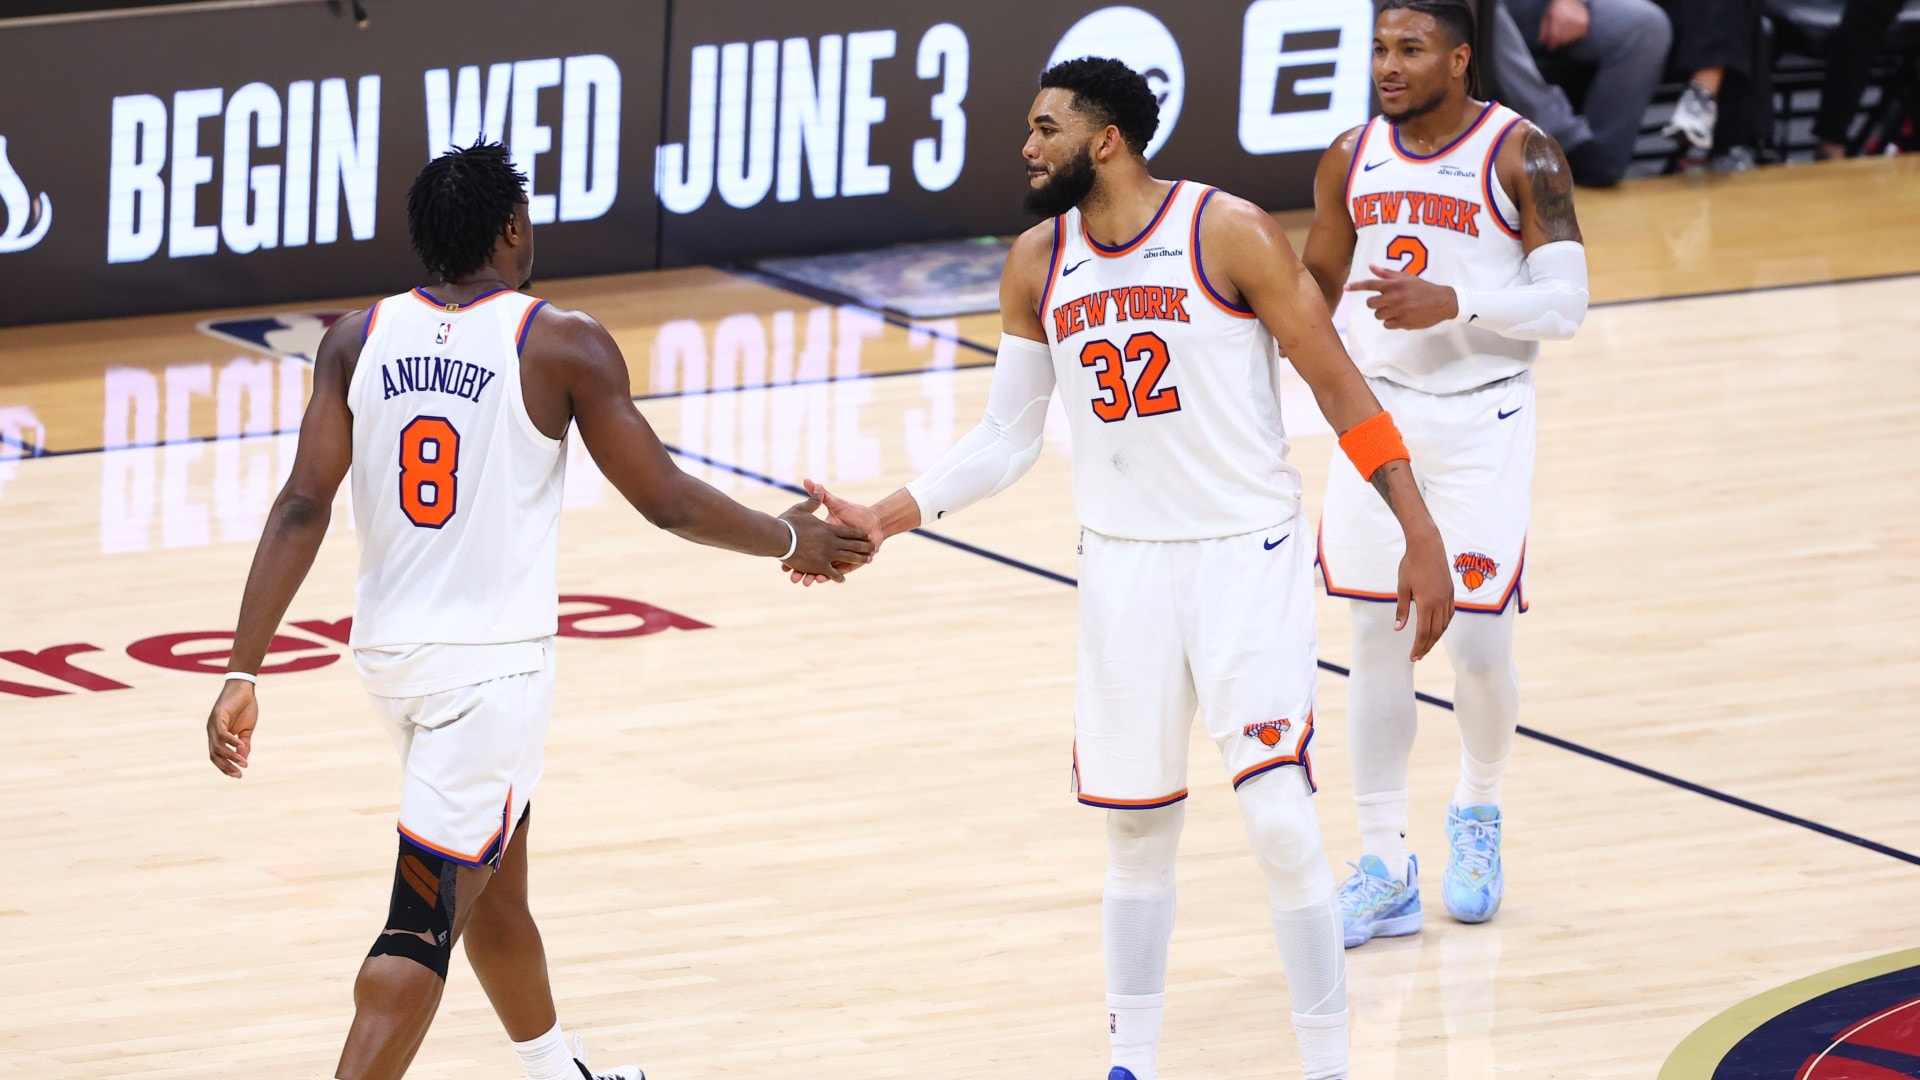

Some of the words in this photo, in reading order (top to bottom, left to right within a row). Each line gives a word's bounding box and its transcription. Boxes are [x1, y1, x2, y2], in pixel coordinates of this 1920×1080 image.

[107, 74, 382, 264] BEGIN
[654, 29, 897, 214] JUNE
[912, 22, 970, 192] 3
[1353, 190, 1404, 231] NEW
[1405, 189, 1481, 238] YORK
[1053, 290, 1110, 344] NEW
[1111, 285, 1191, 324] YORK
[381, 356, 496, 403] ANUNOBY
[1079, 331, 1182, 423] 32
[398, 414, 461, 530] 8
